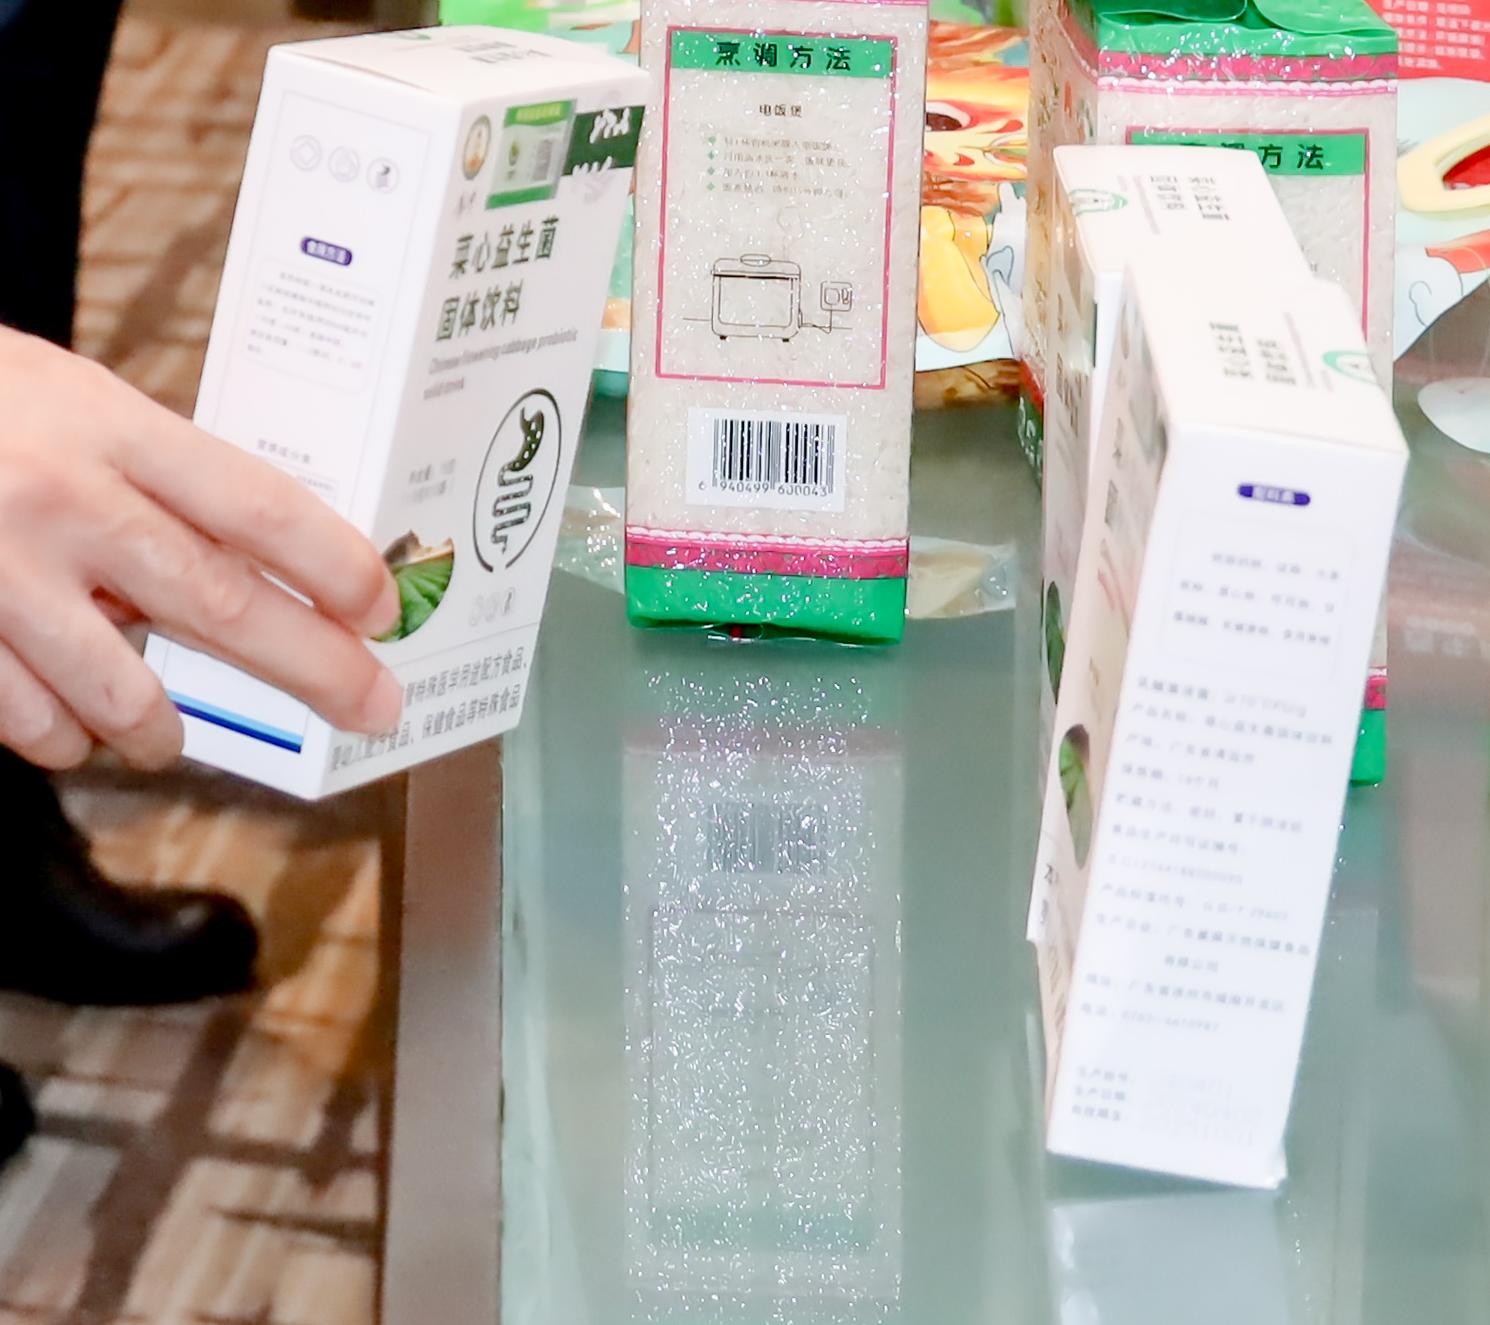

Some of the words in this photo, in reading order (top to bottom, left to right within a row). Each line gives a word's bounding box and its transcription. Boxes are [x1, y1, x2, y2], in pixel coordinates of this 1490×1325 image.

[715, 41, 852, 72] 烹调方法
[449, 214, 559, 279] 菜心益生菌
[435, 278, 524, 342] 固体饮料
[698, 480, 707, 491] 6
[719, 480, 769, 494] 940499
